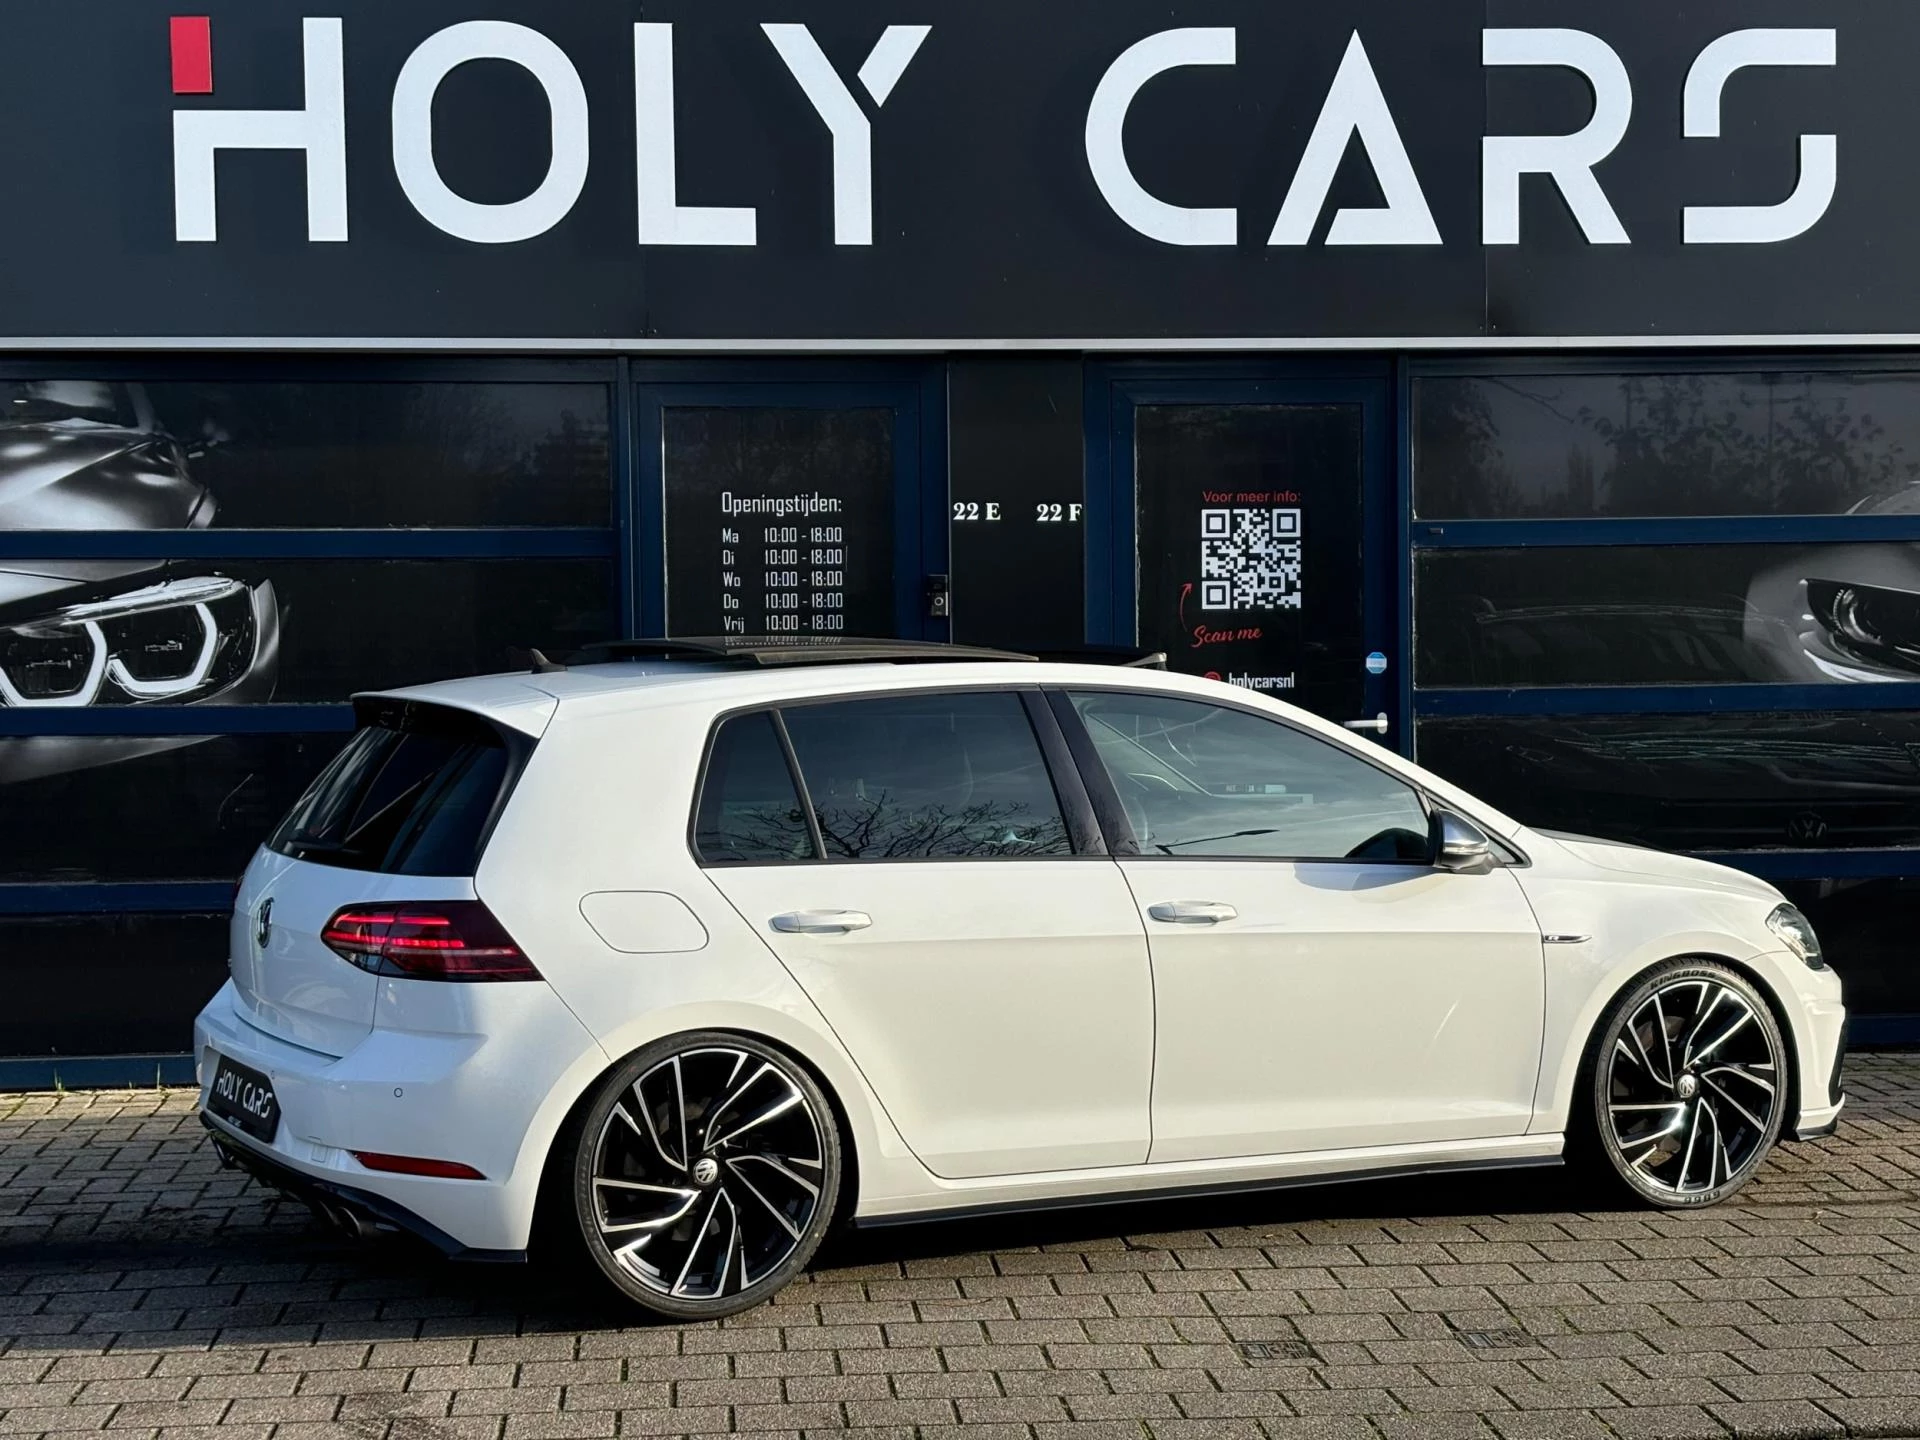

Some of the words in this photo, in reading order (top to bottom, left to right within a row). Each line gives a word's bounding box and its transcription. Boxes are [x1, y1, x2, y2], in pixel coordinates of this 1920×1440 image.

[170, 16, 933, 245] HOLY
[1085, 26, 1838, 246] CARS
[721, 491, 843, 517] Openingstijden:
[1203, 490, 1232, 503] Voor
[1236, 491, 1270, 503] meer
[953, 502, 979, 520] 22
[985, 502, 1001, 520] E
[1036, 503, 1062, 521] 22
[1068, 503, 1083, 521] F
[722, 527, 739, 543] Ma
[764, 527, 798, 543] 10:00
[810, 526, 843, 542] 18:00
[722, 549, 735, 565] Di
[764, 549, 798, 565] 10:00
[810, 548, 843, 564] 18:00
[723, 571, 741, 587] Wo
[765, 571, 799, 587] 10:00
[811, 570, 843, 586] 18:00
[723, 593, 740, 609] Do
[765, 593, 799, 609] 10:00
[811, 592, 843, 608] 18:00
[724, 616, 745, 634] Vrij
[765, 614, 799, 630] 10:00
[811, 614, 843, 629] 18:00
[1191, 624, 1234, 649] Scan
[1237, 627, 1263, 640] me
[1228, 671, 1295, 690] holycarsnl
[216, 1069, 243, 1102] HOLY
[243, 1082, 273, 1119] CARS
